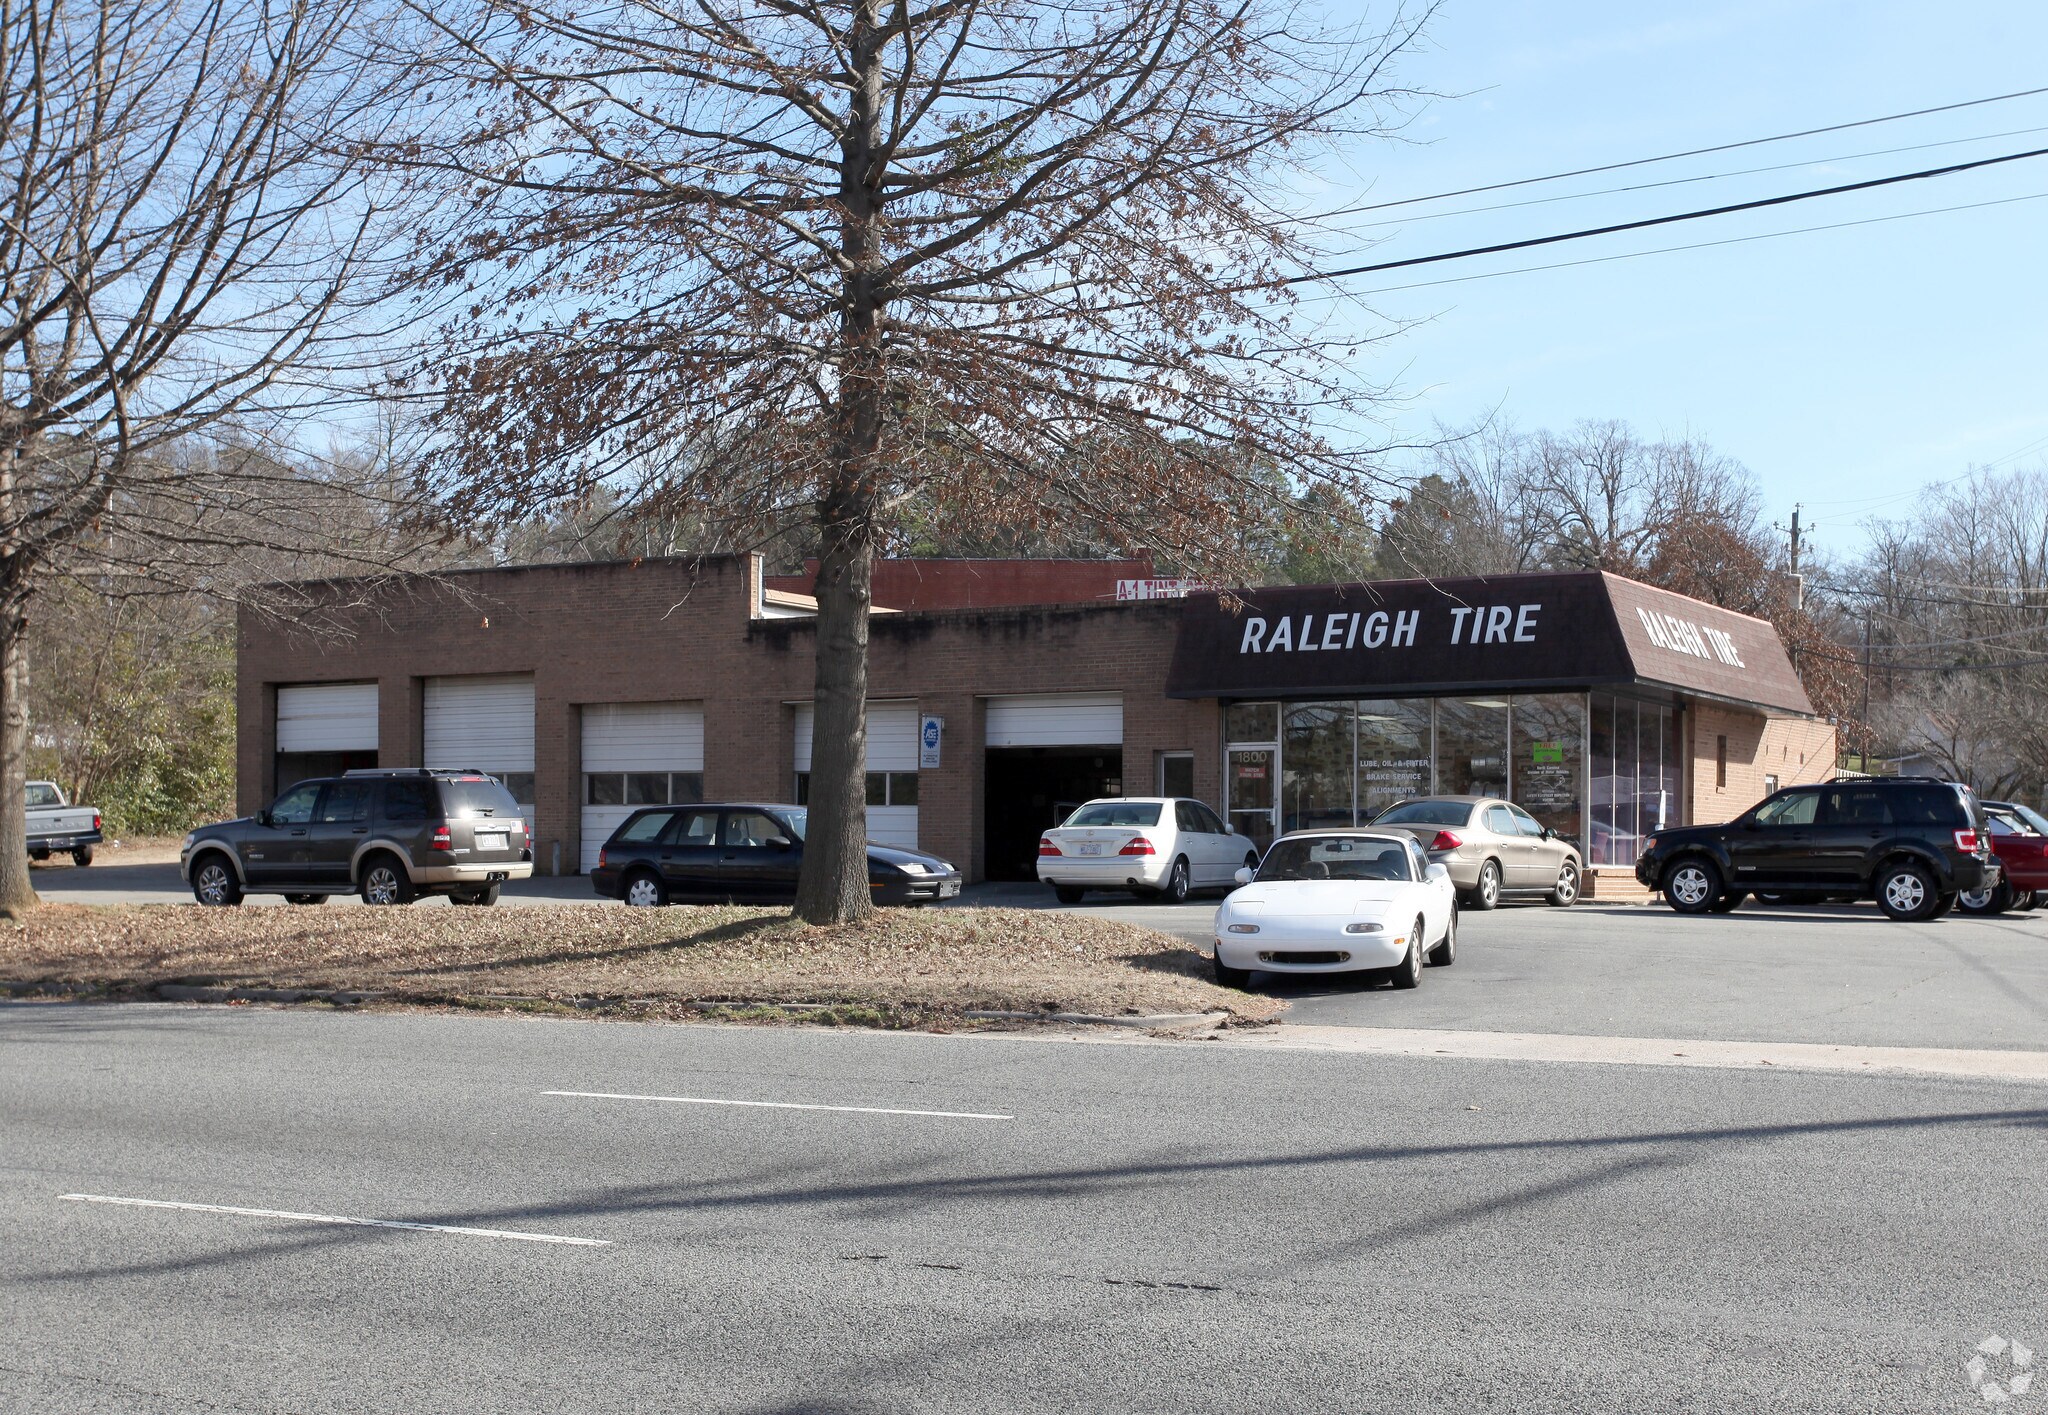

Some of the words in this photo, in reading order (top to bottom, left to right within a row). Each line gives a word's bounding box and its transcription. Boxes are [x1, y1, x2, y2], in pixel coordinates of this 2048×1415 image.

[1118, 580, 1138, 599] A-1
[1240, 609, 1420, 654] RALEIGH
[1450, 603, 1542, 645] TIRE
[1635, 606, 1711, 660] RALEIGH
[1702, 625, 1746, 669] TIRE
[1238, 751, 1267, 762] 1800
[1360, 760, 1380, 768] LUBE,
[1372, 786, 1416, 794] ALIGNMENTS
